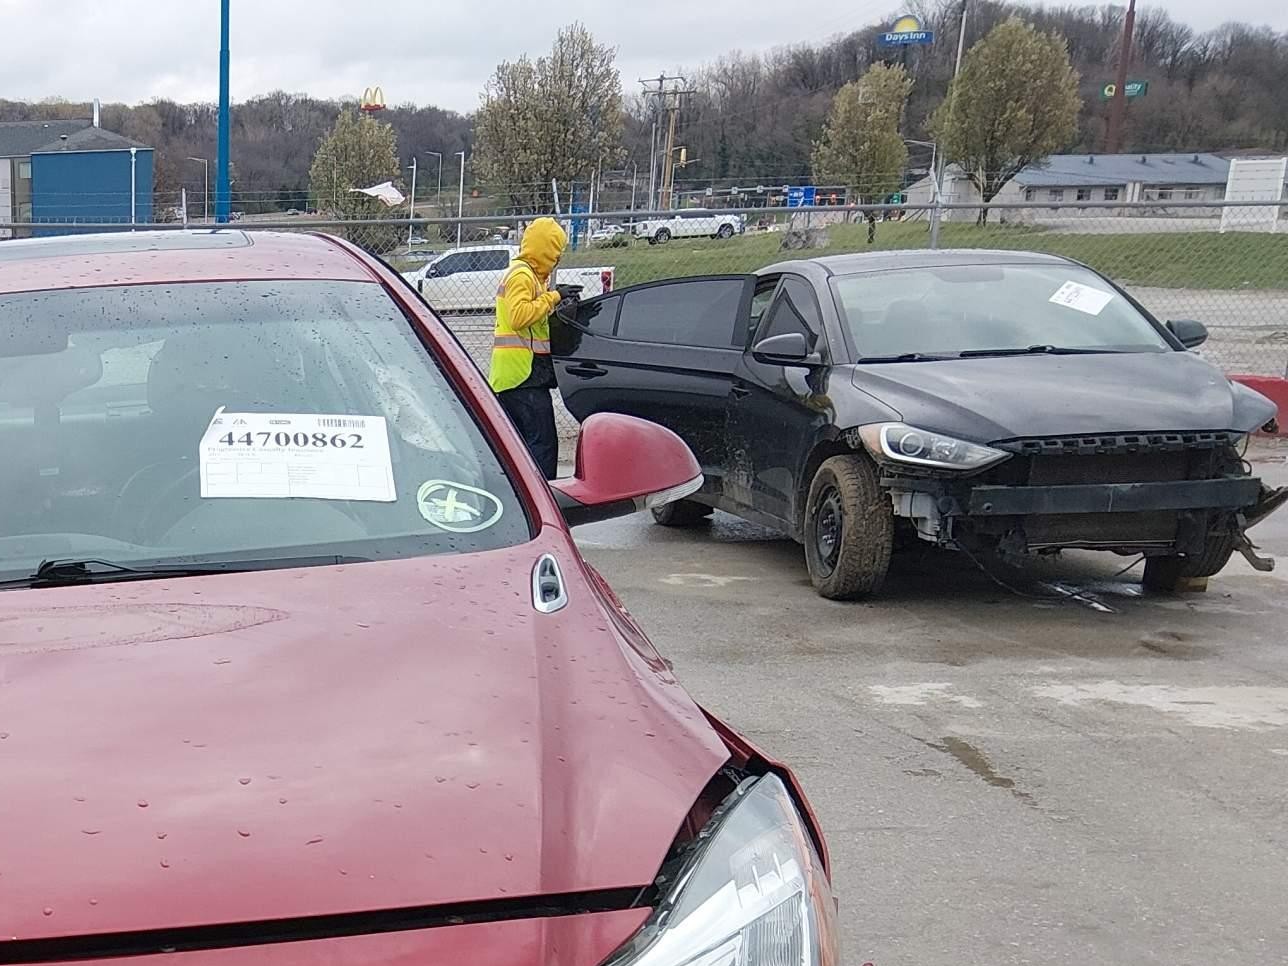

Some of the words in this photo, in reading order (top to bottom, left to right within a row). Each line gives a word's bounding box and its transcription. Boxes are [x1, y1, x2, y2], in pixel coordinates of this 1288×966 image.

[885, 32, 909, 43] Days
[910, 32, 926, 40] Inn
[219, 431, 365, 449] 44700862
